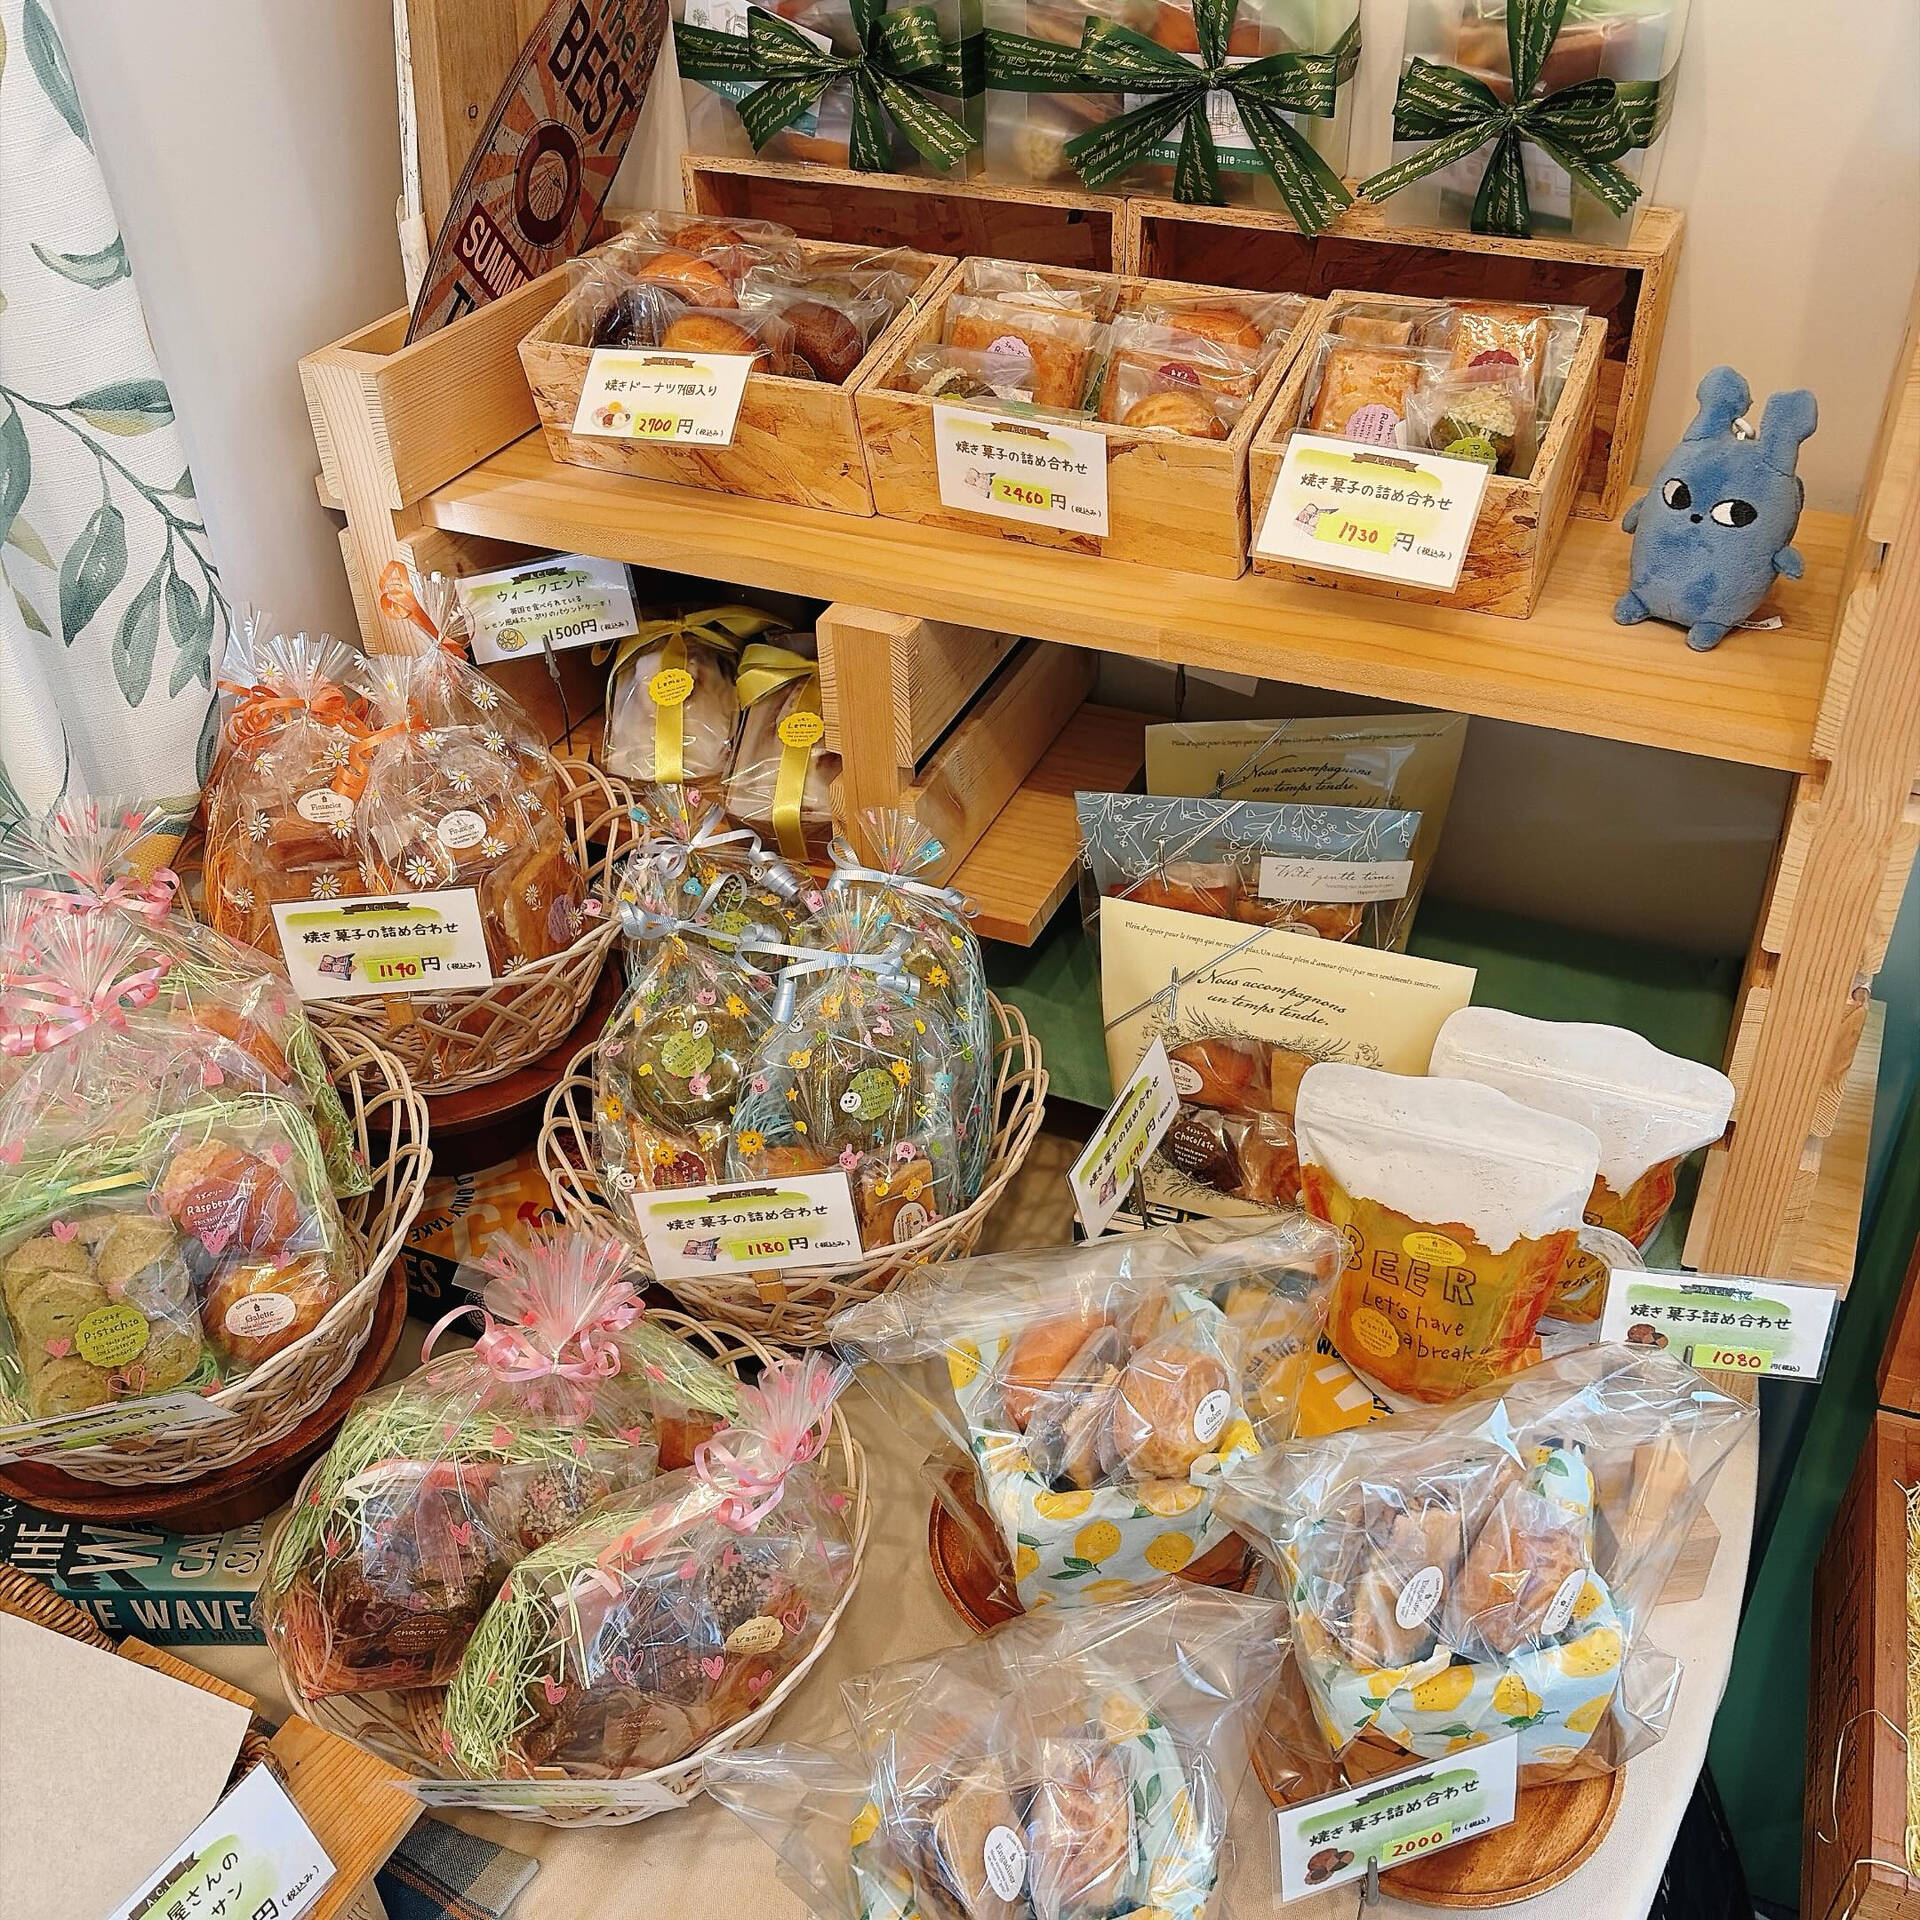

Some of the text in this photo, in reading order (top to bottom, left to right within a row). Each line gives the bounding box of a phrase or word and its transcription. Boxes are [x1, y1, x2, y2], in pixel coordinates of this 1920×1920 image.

[548, 0, 637, 155] BEST
[462, 215, 529, 297] SUMM
[638, 418, 673, 434] 2700
[676, 418, 694, 435] 円
[955, 440, 1088, 475] 焼き菓子の詰め合わせ
[1002, 484, 1044, 506] 2460
[1050, 493, 1067, 511] 円
[1300, 473, 1453, 511] 焼き菓子の詰め合わせ
[1338, 521, 1379, 544] 1730
[1393, 531, 1415, 552] 円
[496, 575, 588, 603] ウィークエンド
[1252, 784, 1272, 793] un
[1273, 780, 1312, 797] temps
[1311, 870, 1358, 887] gentle
[302, 922, 459, 944] 焼き菓子の詰め合わせ
[421, 956, 441, 973] 円
[1207, 994, 1329, 1026] un temps tendre.
[1242, 979, 1347, 1015] accompagnons
[1174, 1131, 1215, 1151] Chocolate
[666, 1205, 829, 1232] 焼き菓子の詰め合わせ
[747, 1241, 785, 1257] 1180
[788, 1236, 809, 1251] 円
[1342, 1224, 1477, 1306] BEER
[1362, 1281, 1409, 1320] Let's
[83, 1318, 139, 1343] Pistachio
[1415, 1305, 1465, 1337] have
[1630, 1304, 1793, 1331] 焼き菓子詰め合わせ
[1402, 1332, 1413, 1350] a
[1713, 1351, 1762, 1368] 1080
[131, 1599, 259, 1631] WAVE
[1308, 1779, 1480, 1847] 焼き菓子詰め合わせ
[1391, 1831, 1444, 1858] 2000
